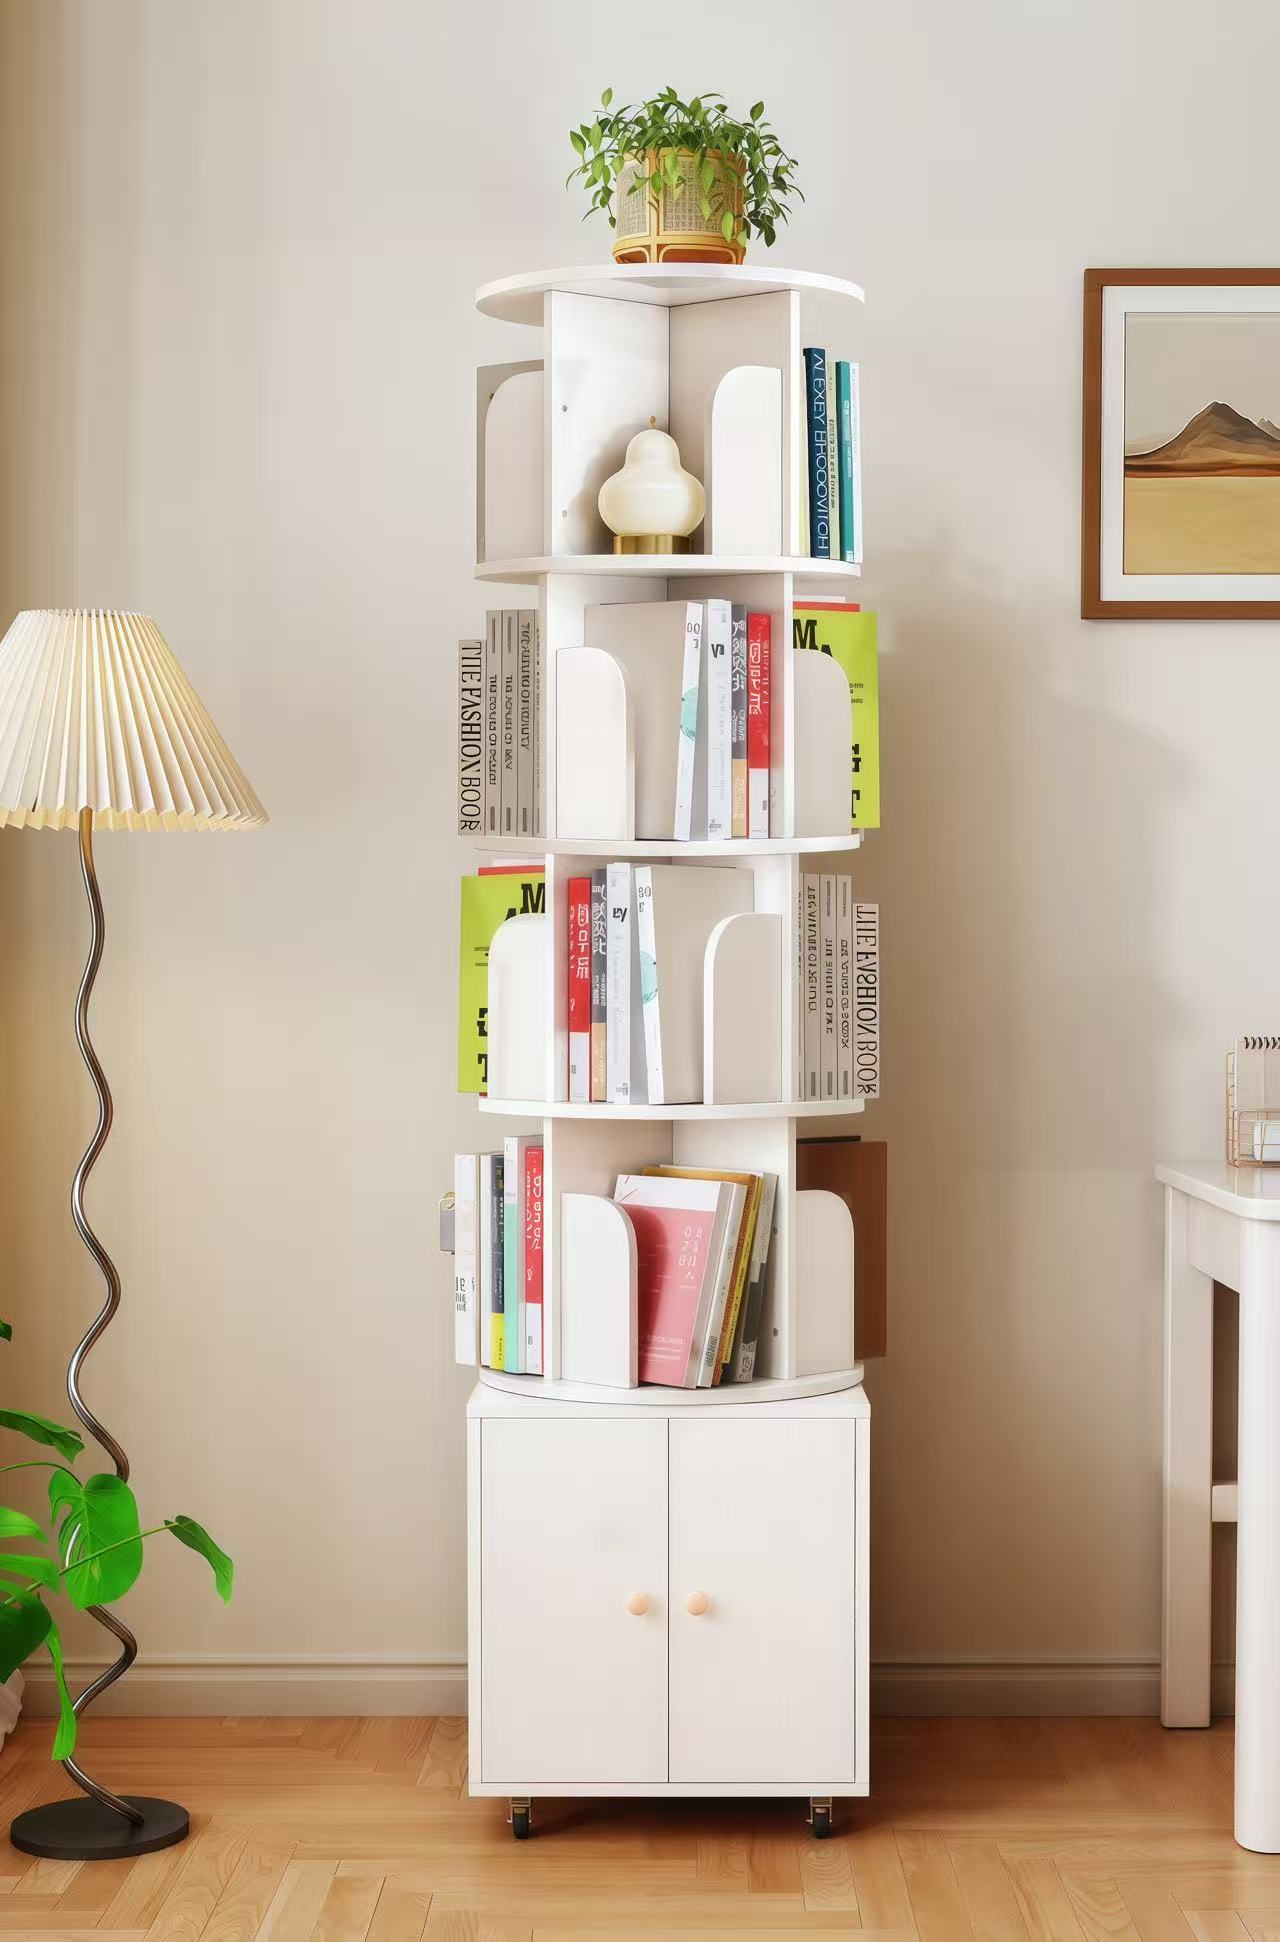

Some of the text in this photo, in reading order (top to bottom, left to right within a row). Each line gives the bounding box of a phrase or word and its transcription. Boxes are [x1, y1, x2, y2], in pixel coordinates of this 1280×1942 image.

[813, 353, 826, 425] ALEXEY
[461, 641, 482, 682] THE
[461, 687, 482, 772] FASHION
